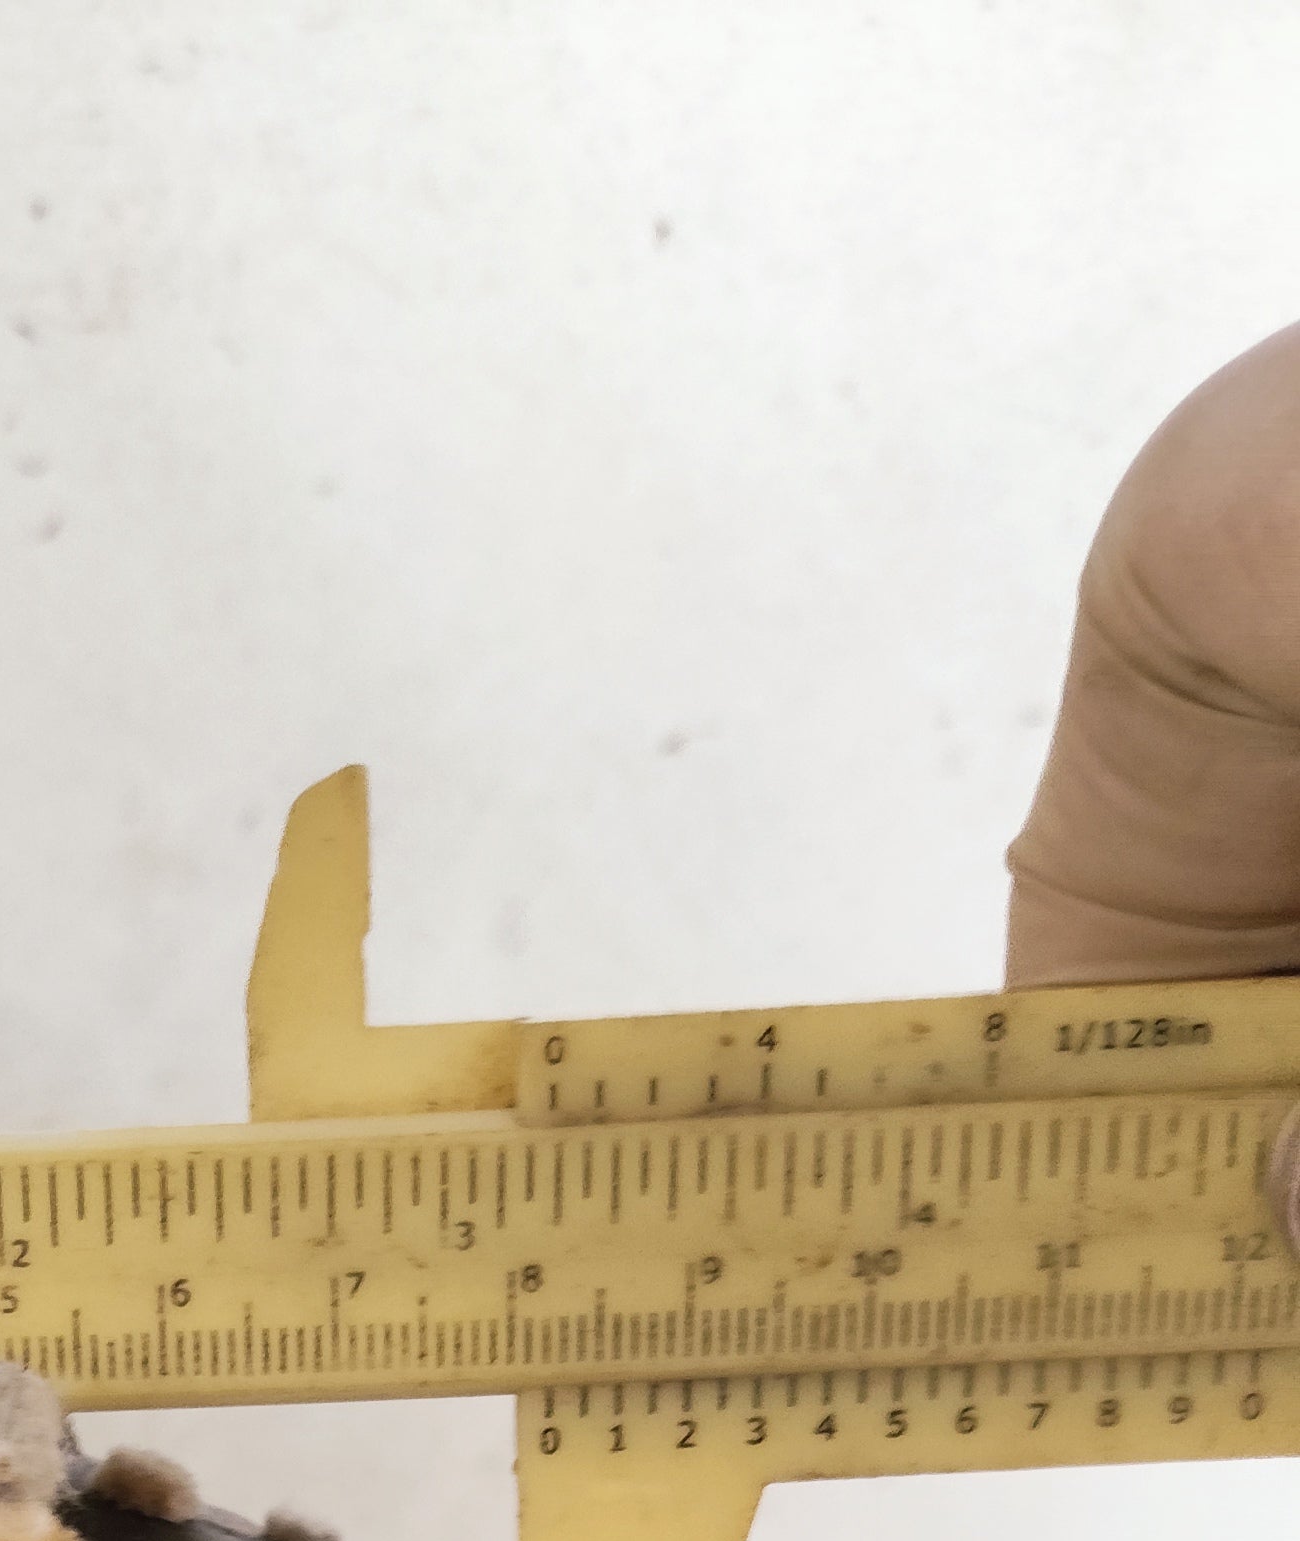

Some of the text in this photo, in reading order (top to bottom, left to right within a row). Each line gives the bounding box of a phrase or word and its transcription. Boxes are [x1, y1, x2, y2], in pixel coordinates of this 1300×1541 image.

[544, 1034, 567, 1065] 0
[756, 1023, 780, 1053] 4
[983, 1012, 1007, 1042] 8
[11, 1238, 31, 1268] 2
[455, 1220, 476, 1252] 3
[911, 1201, 937, 1226] 4
[0, 1284, 20, 1314] 5
[169, 1277, 193, 1308] 6
[344, 1271, 367, 1296] 7
[521, 1262, 545, 1294] 8
[700, 1255, 724, 1285] 9
[851, 1248, 902, 1278] 10
[1035, 1242, 1082, 1271] 11
[1220, 1232, 1271, 1262] 12
[539, 1392, 1265, 1456] 0 1 2 3 4 5 6 7 8 9 0
